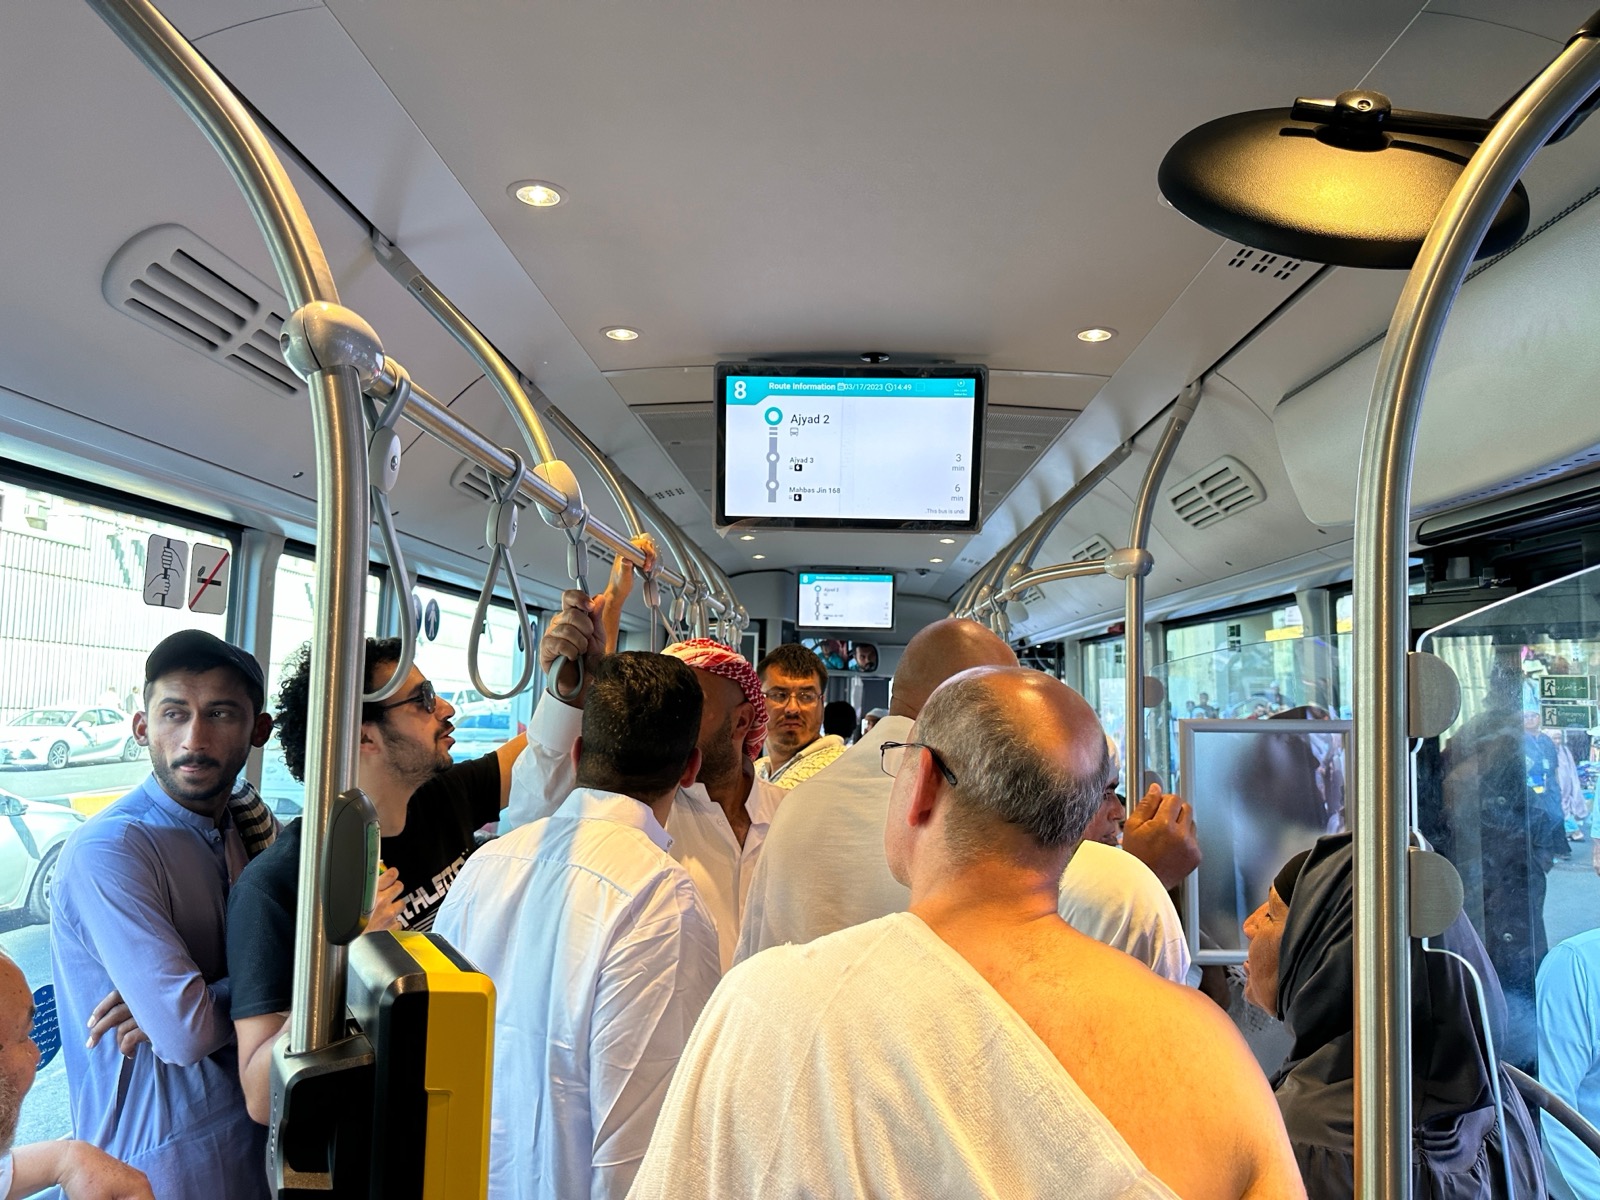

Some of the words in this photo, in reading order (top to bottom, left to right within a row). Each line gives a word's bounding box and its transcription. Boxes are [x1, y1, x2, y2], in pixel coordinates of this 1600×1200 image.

[734, 381, 747, 399] 8
[769, 382, 791, 390] Route
[792, 382, 836, 391] Information
[843, 383, 883, 391] 03/17/2023
[790, 414, 820, 426] Ajyad
[823, 414, 830, 424] 2
[955, 453, 962, 462] 3
[954, 484, 961, 492] 6
